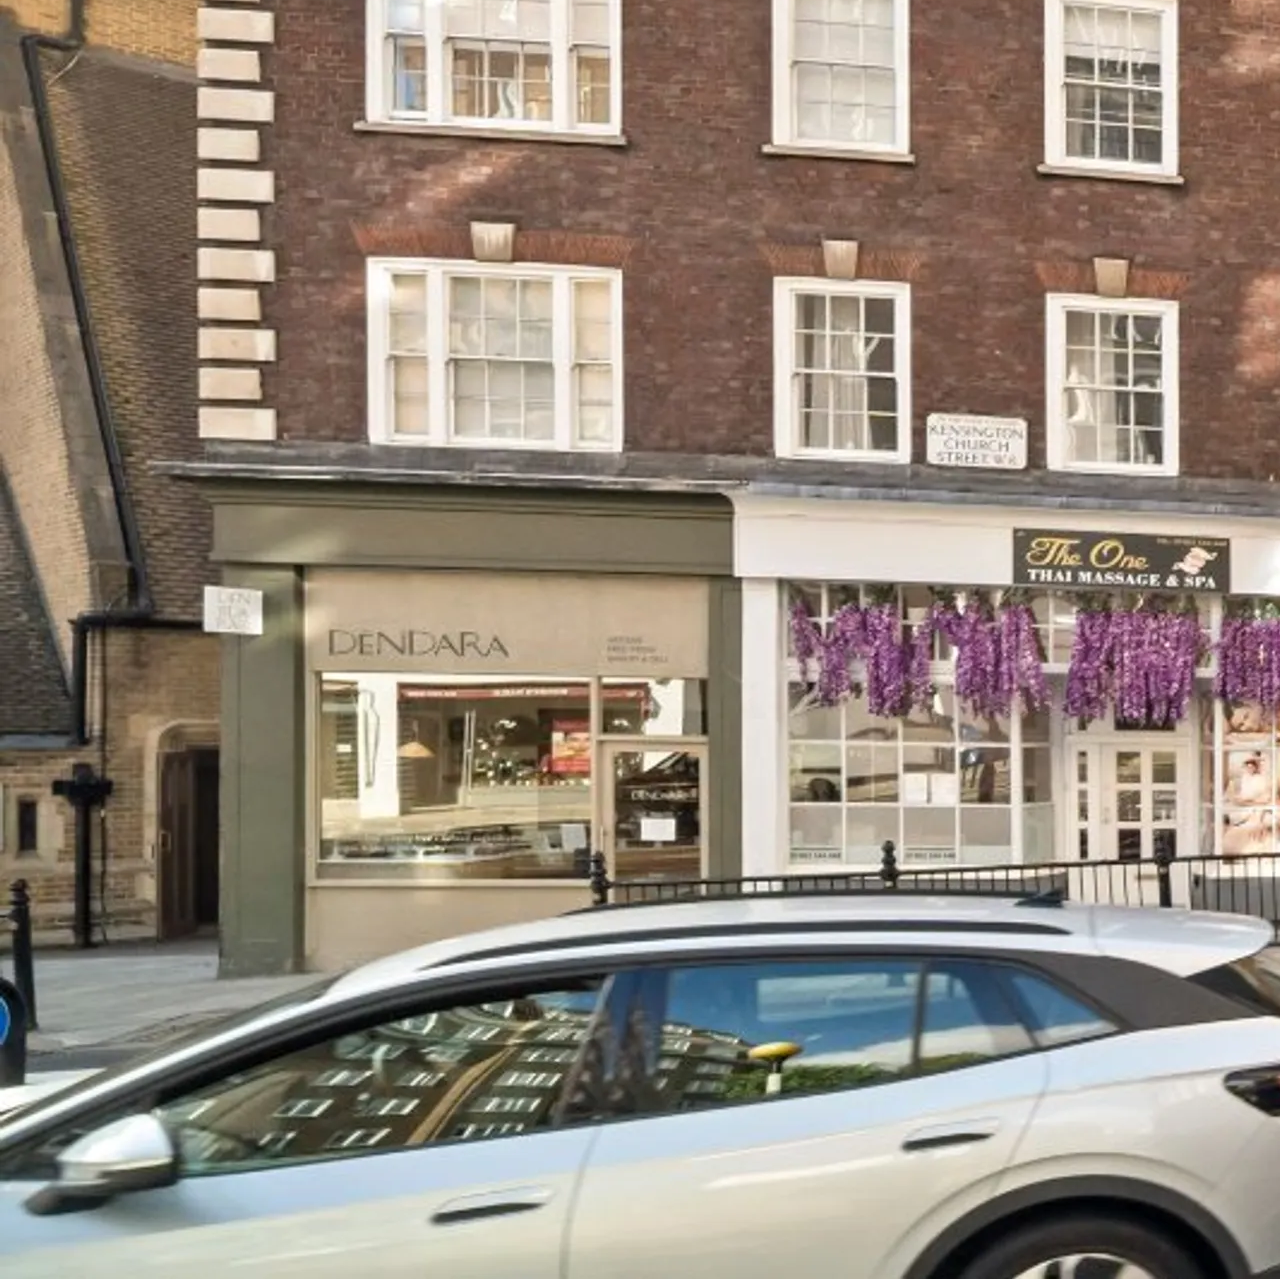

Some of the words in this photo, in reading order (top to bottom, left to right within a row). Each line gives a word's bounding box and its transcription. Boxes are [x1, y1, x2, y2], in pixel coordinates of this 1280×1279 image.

[928, 424, 1024, 440] KENSINGTON
[943, 438, 1009, 452] CHURCH
[936, 451, 991, 463] STREET
[1025, 537, 1084, 566] The
[1090, 538, 1149, 570] One
[1027, 569, 1072, 583] THAI
[1077, 571, 1160, 587] MASSAGE
[1166, 574, 1180, 587] &
[1183, 575, 1216, 589] SPA
[328, 629, 510, 658] DENDARA
